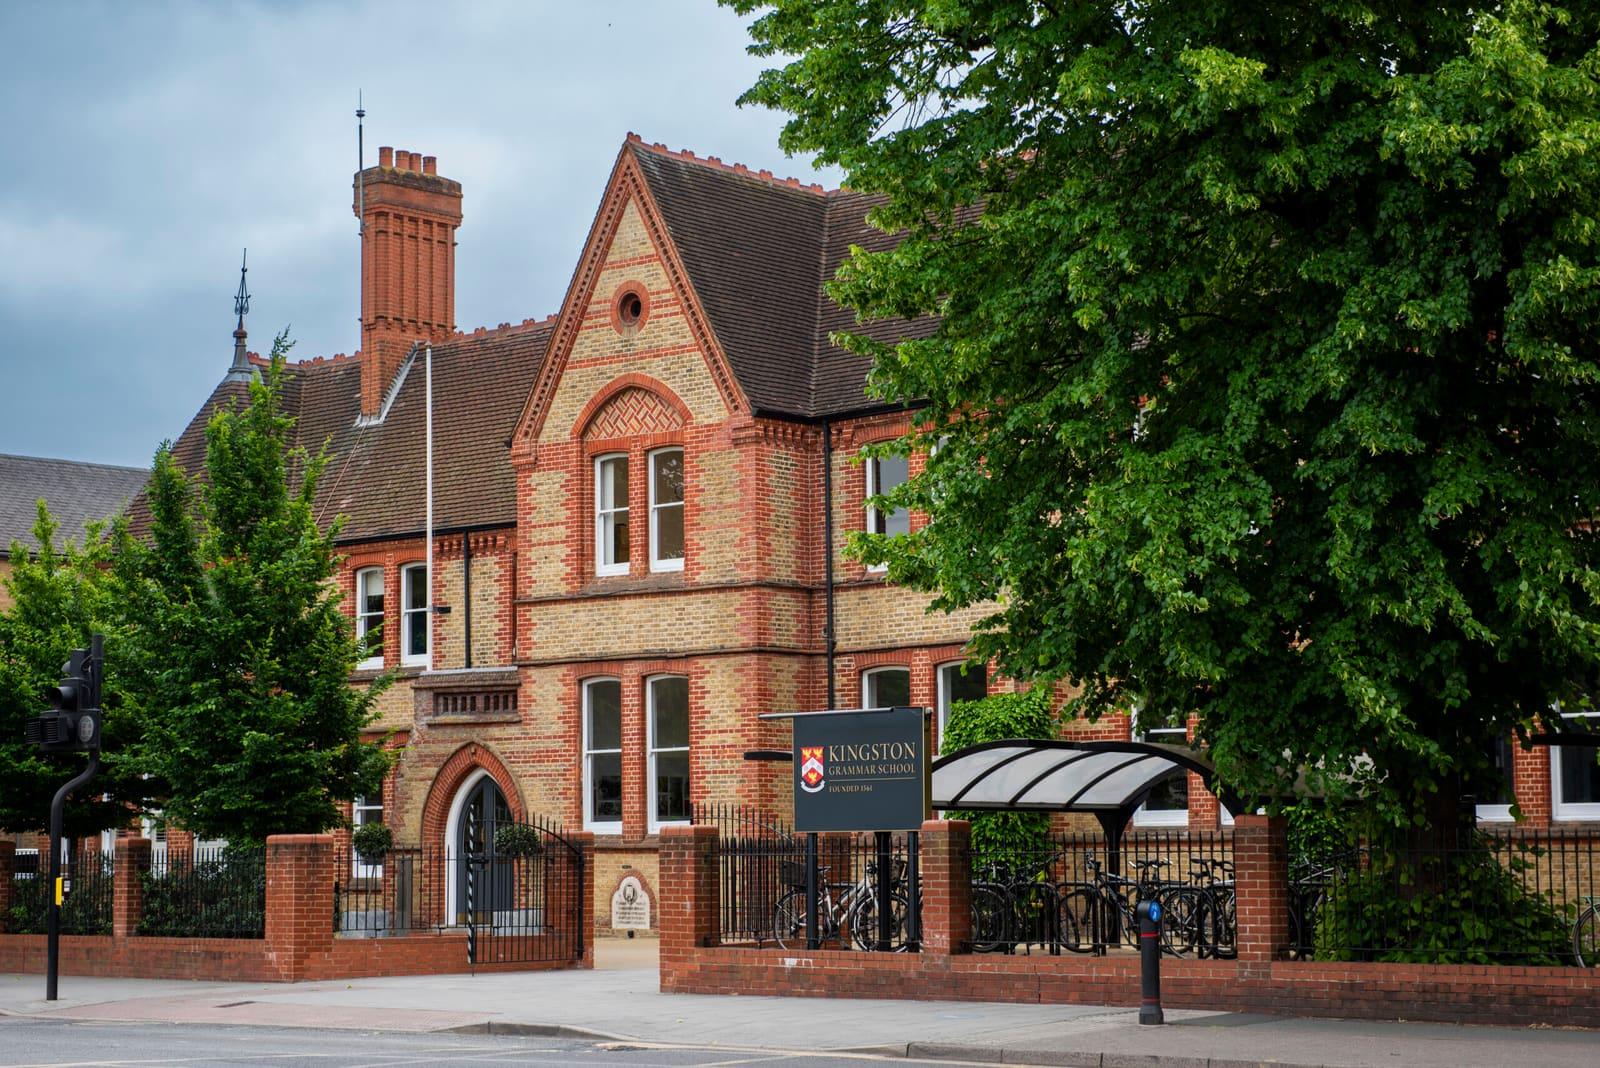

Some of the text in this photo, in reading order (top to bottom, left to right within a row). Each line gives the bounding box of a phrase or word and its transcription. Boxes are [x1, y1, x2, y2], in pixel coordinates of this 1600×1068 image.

[829, 742, 916, 762] KINGSTON
[828, 763, 916, 776] GRAMMAR SCHOOL
[829, 785, 859, 793] FOUNDED
